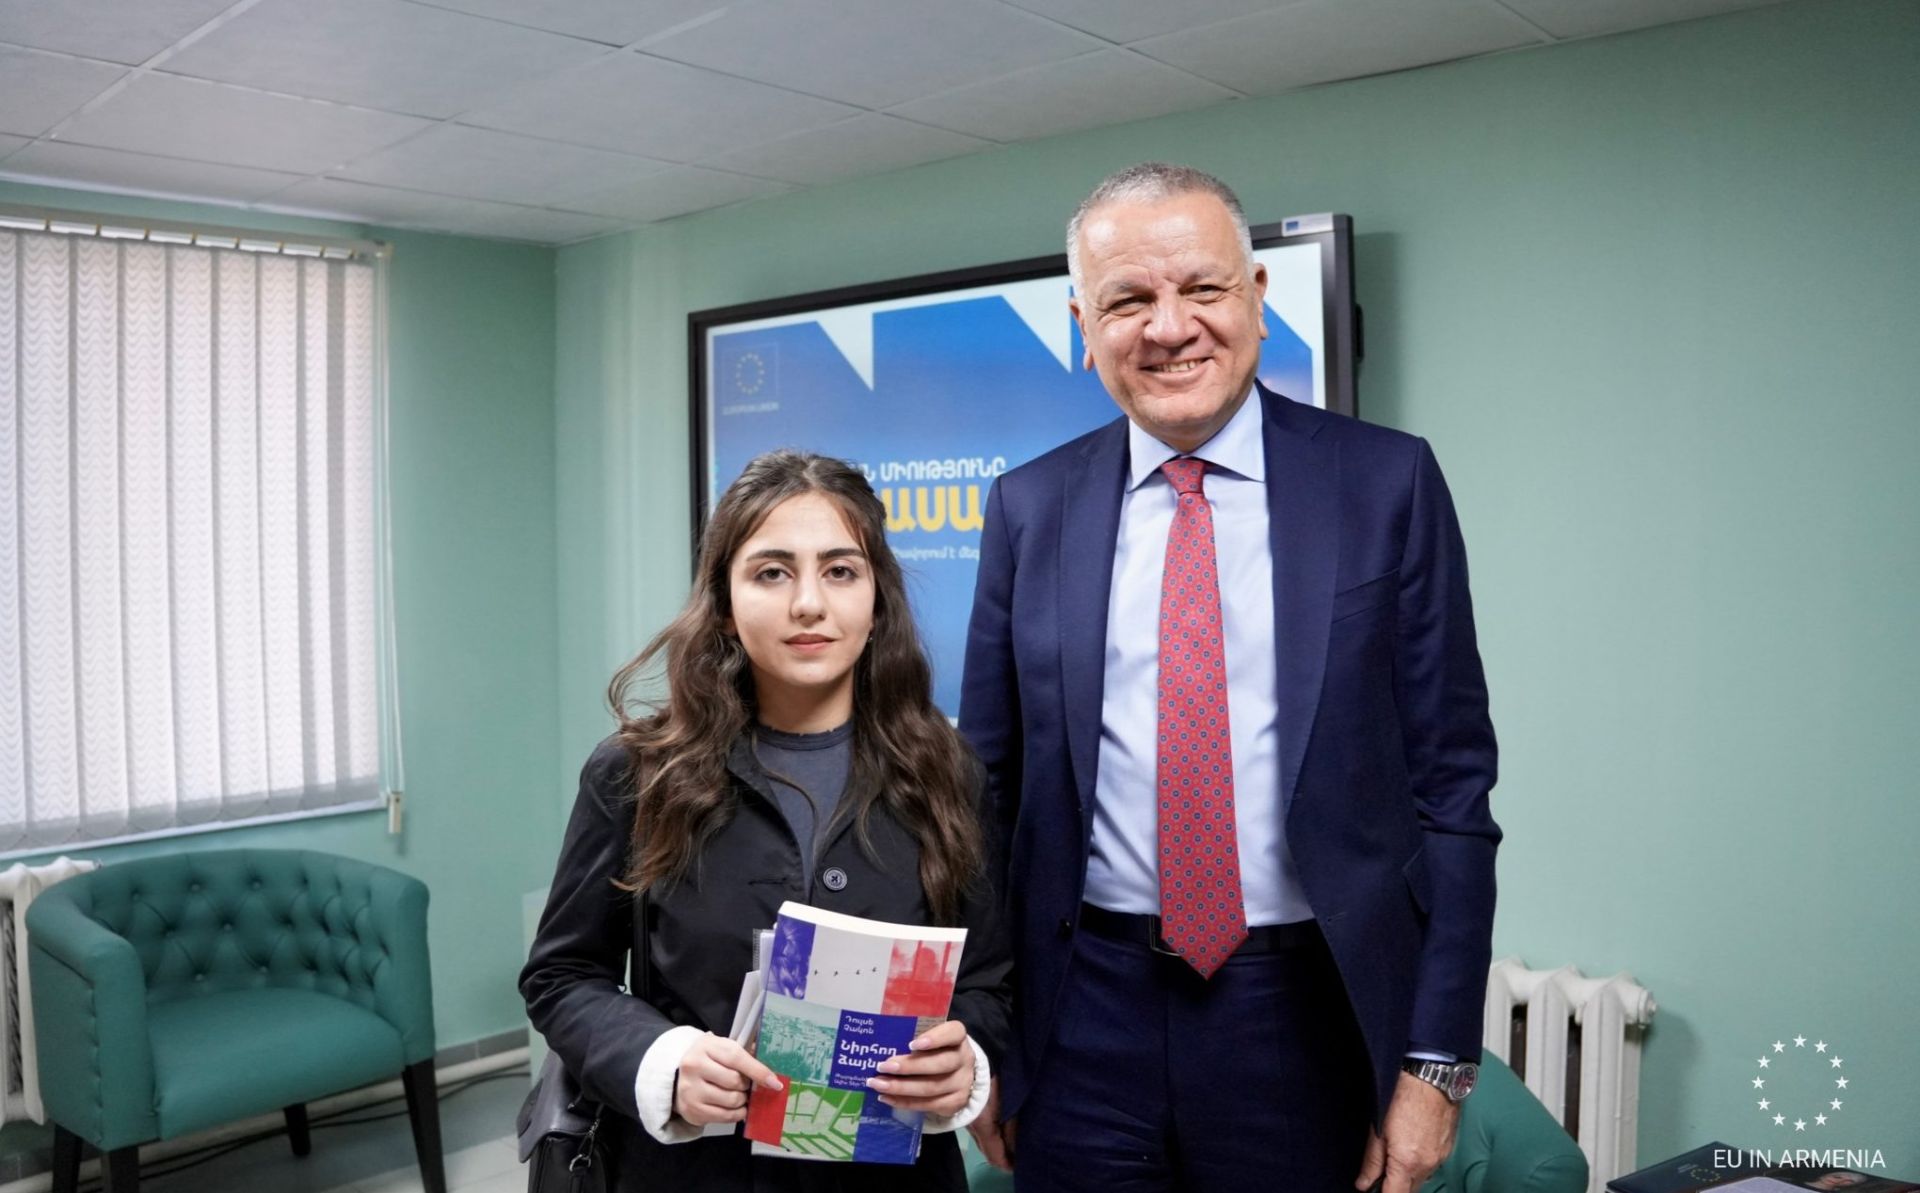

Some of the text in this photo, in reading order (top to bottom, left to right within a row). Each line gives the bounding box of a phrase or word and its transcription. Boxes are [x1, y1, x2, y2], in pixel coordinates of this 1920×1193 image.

[880, 486, 984, 533] ԱՍԱ
[840, 1039, 897, 1056] Նիրհող
[838, 1053, 876, 1070] ձայն
